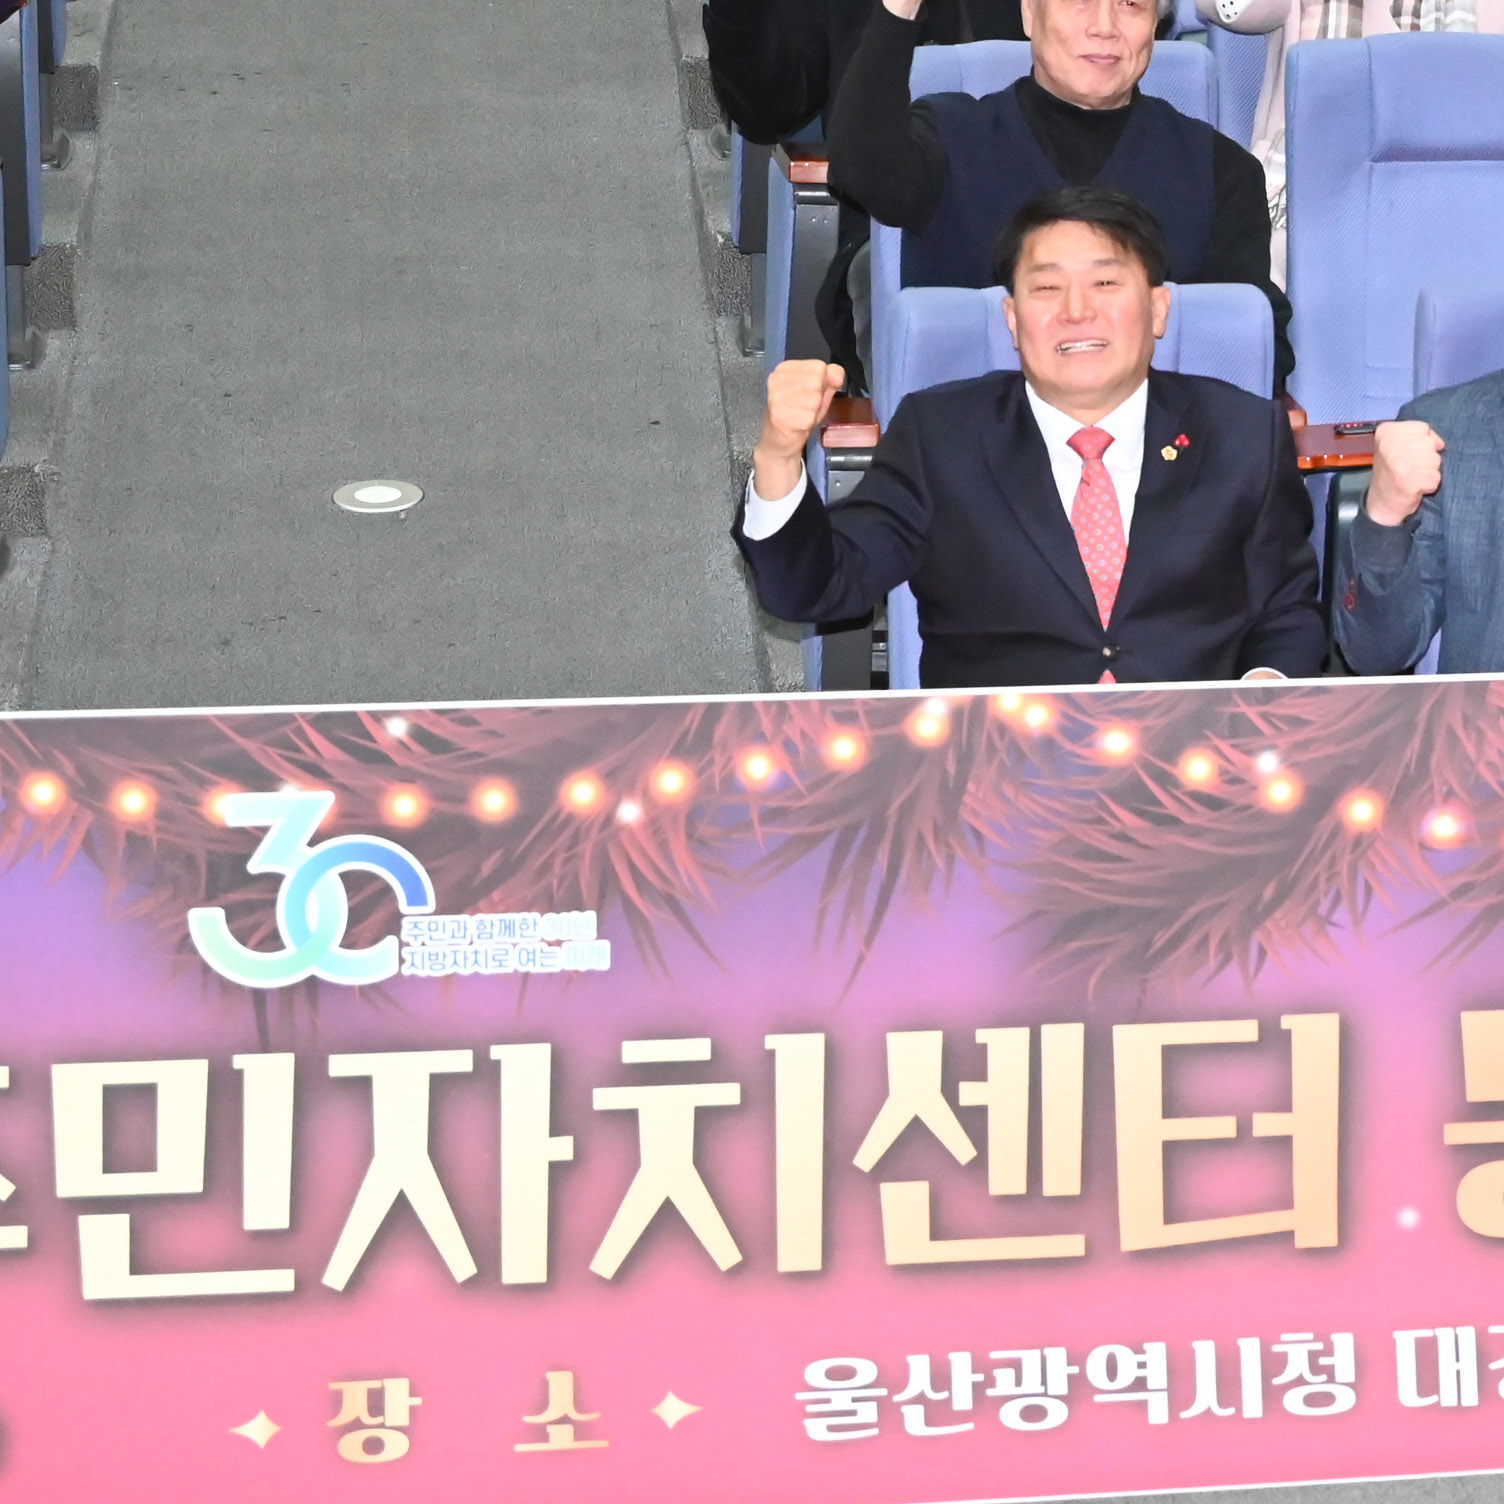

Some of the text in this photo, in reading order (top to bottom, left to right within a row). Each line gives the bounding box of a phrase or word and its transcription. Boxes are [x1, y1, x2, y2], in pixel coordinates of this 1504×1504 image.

[406, 919, 470, 942] 주민과
[476, 917, 538, 939] 함께한
[407, 947, 510, 973] 지방자치로
[518, 947, 559, 968] 여는
[0, 1011, 1339, 1300] 민자치센터
[794, 1332, 1359, 1442] 울산광역시청
